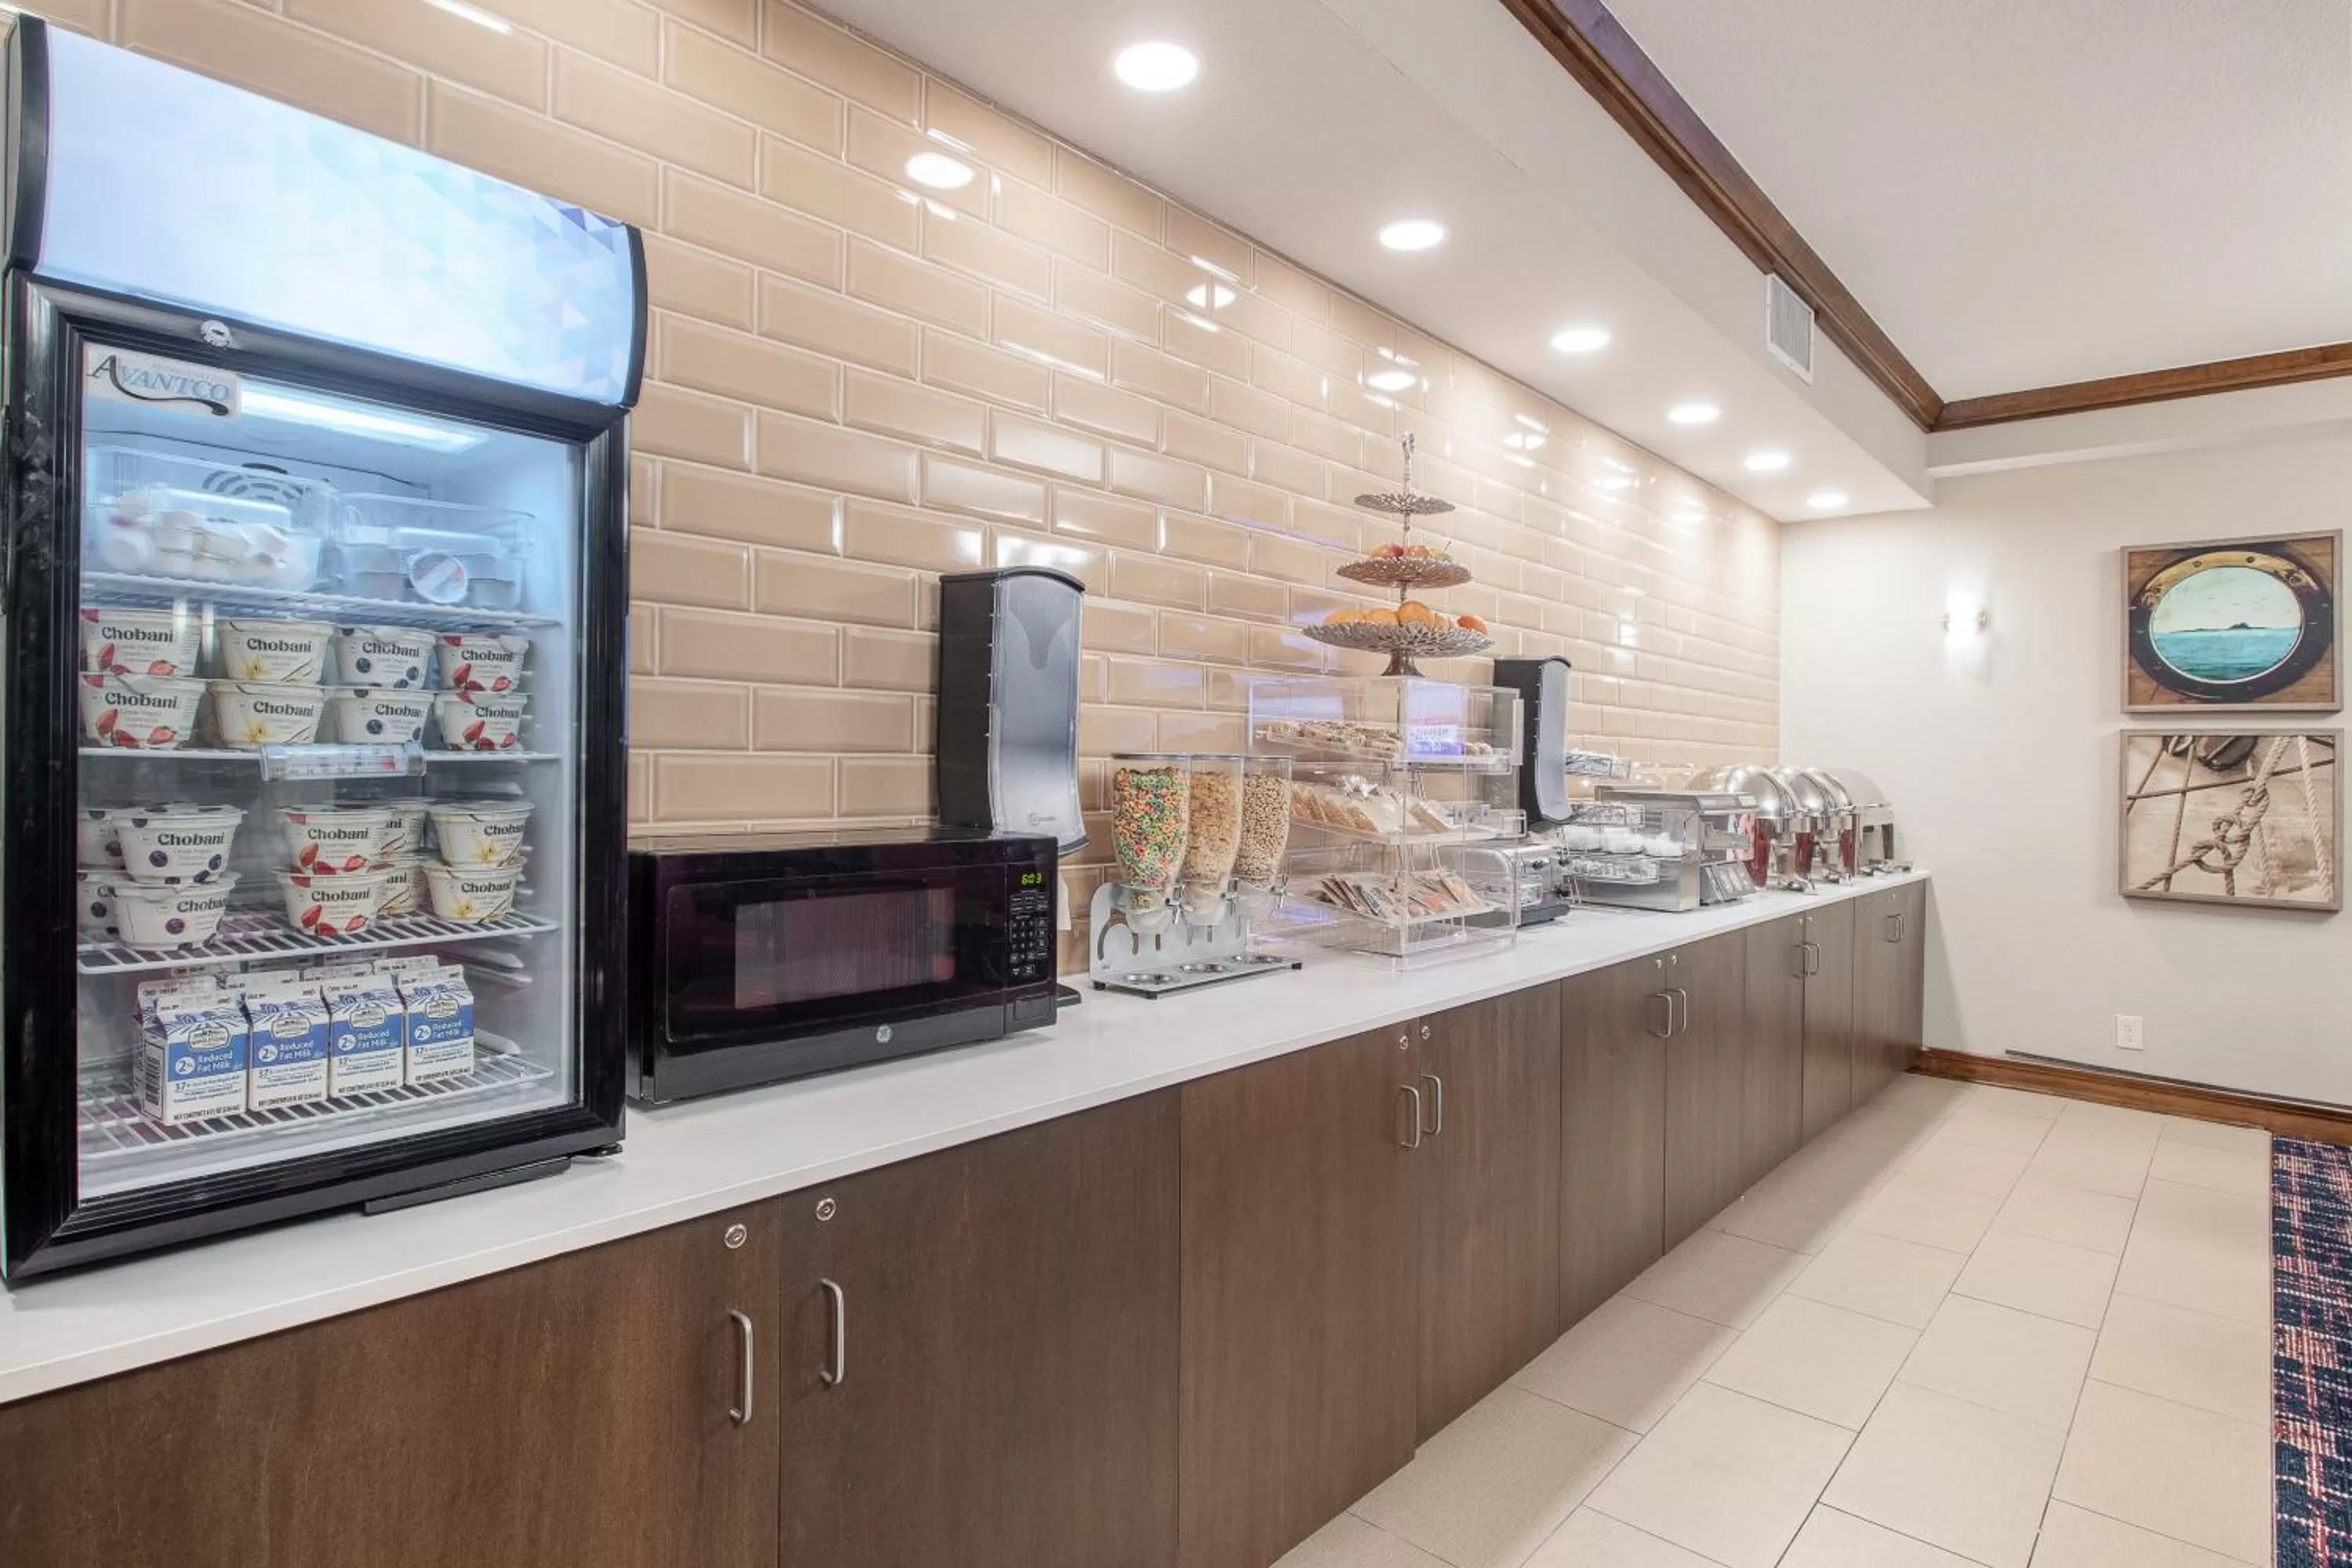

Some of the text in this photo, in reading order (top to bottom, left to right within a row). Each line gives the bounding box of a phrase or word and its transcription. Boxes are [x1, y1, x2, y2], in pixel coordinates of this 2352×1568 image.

[102, 626, 172, 643] Chobani
[247, 637, 313, 653] Chobani
[362, 641, 420, 658] Chobani
[461, 649, 514, 662] Chobani
[104, 691, 178, 710] Chobani
[253, 701, 314, 717] Chobani
[158, 832, 225, 846] Chobani
[307, 828, 369, 840] Chobani
[311, 887, 371, 902] Chobani
